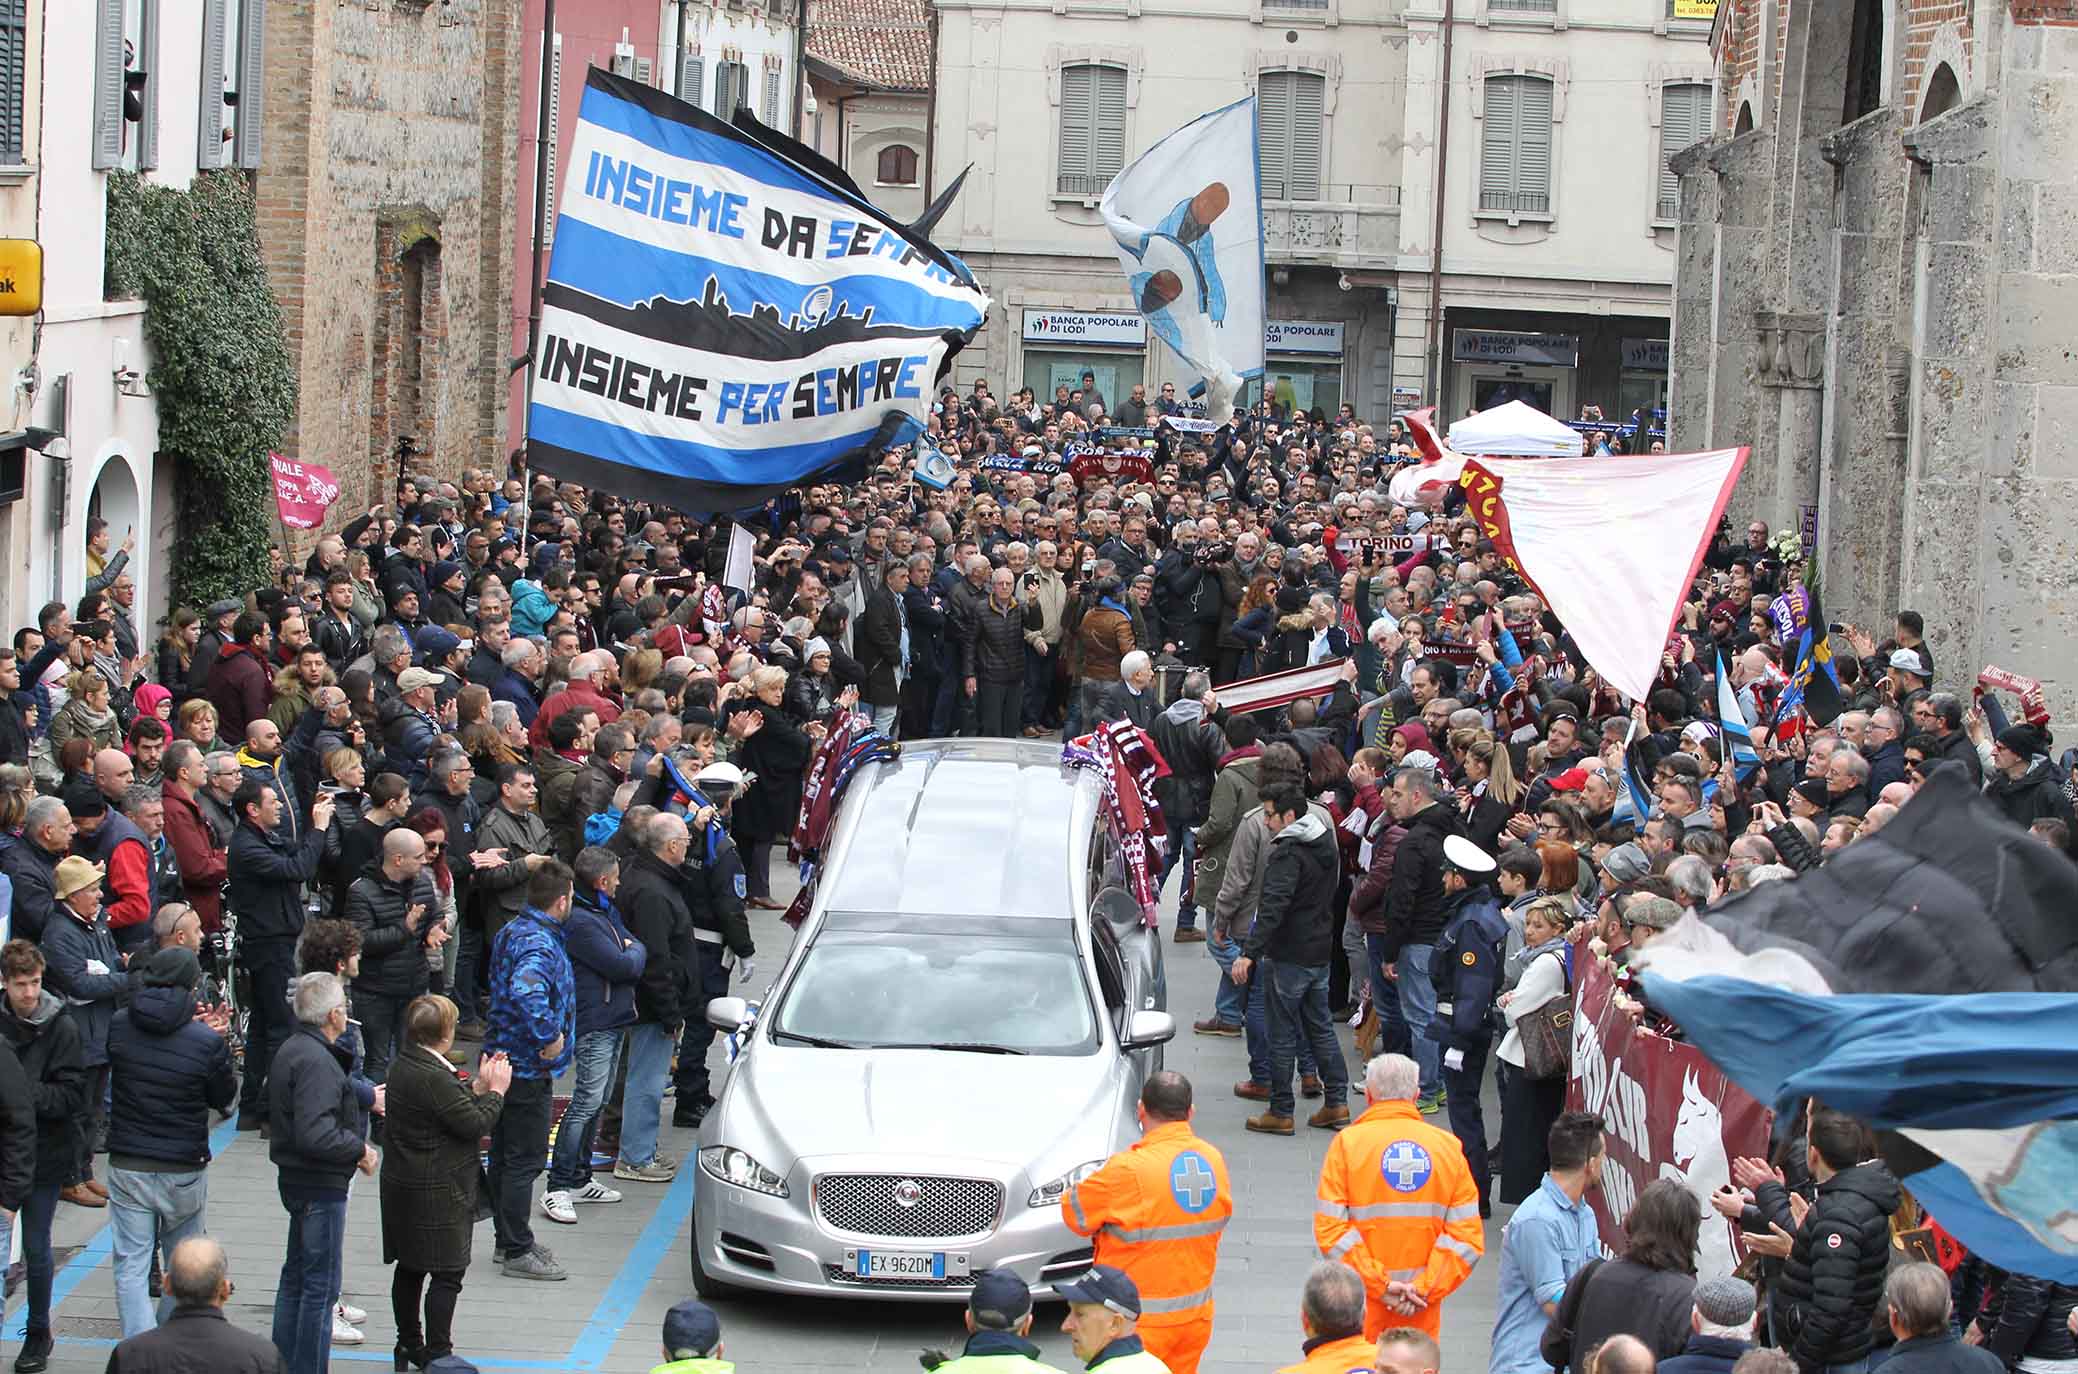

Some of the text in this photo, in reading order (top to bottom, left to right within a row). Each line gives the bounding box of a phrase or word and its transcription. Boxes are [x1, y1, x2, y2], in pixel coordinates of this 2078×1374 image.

[585, 150, 965, 288] INSIEME DA SEMP
[1050, 316, 1140, 328] BANCA POPOLARE
[1050, 325, 1086, 334] DI LODI
[1284, 326, 1336, 337] POPOLARE
[1266, 334, 1281, 343] ODI
[1480, 336, 1570, 350] BANCA POPOLARE
[1480, 345, 1516, 355] DI LODI
[539, 334, 929, 424] INSIEME PER SEMPRE
[1350, 537, 1413, 549] TORINO
[871, 1256, 933, 1273] EX 962DM
